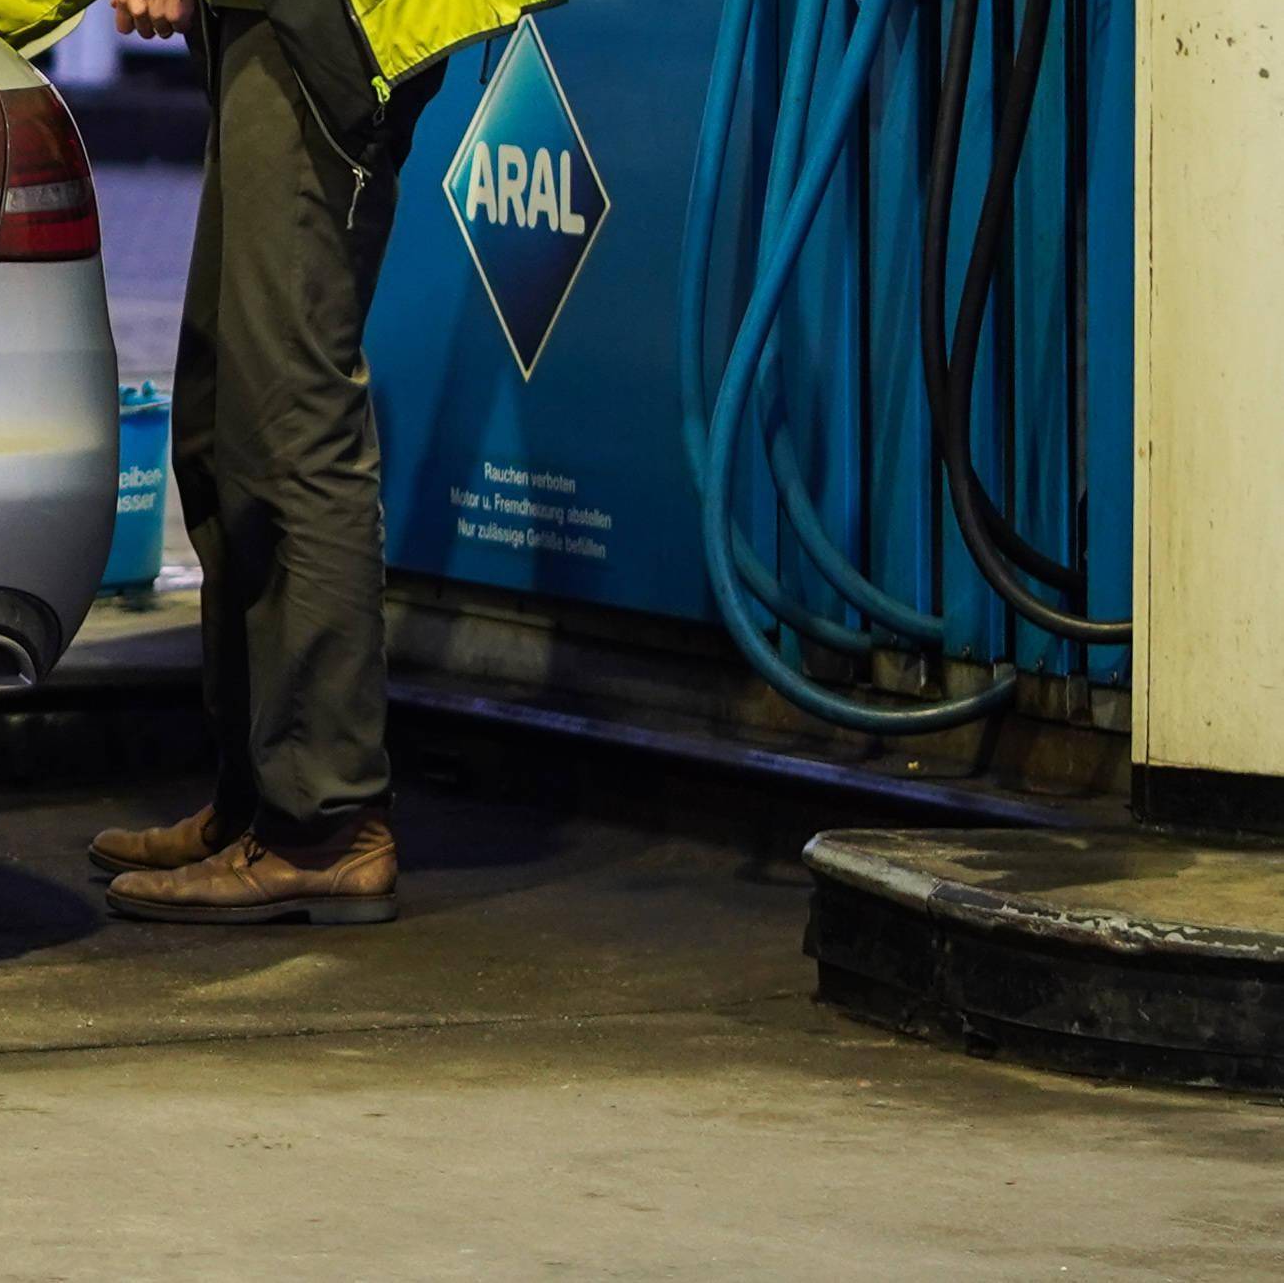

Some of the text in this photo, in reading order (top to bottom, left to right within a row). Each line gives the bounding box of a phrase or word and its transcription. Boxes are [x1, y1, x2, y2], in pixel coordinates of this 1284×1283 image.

[466, 140, 585, 235] ARAL
[484, 461, 576, 493] Rauchen verboten
[450, 486, 612, 529] Motor u. Fremdheizung abstellen
[458, 517, 607, 559] Nur zulässige Gefäße befüllen
